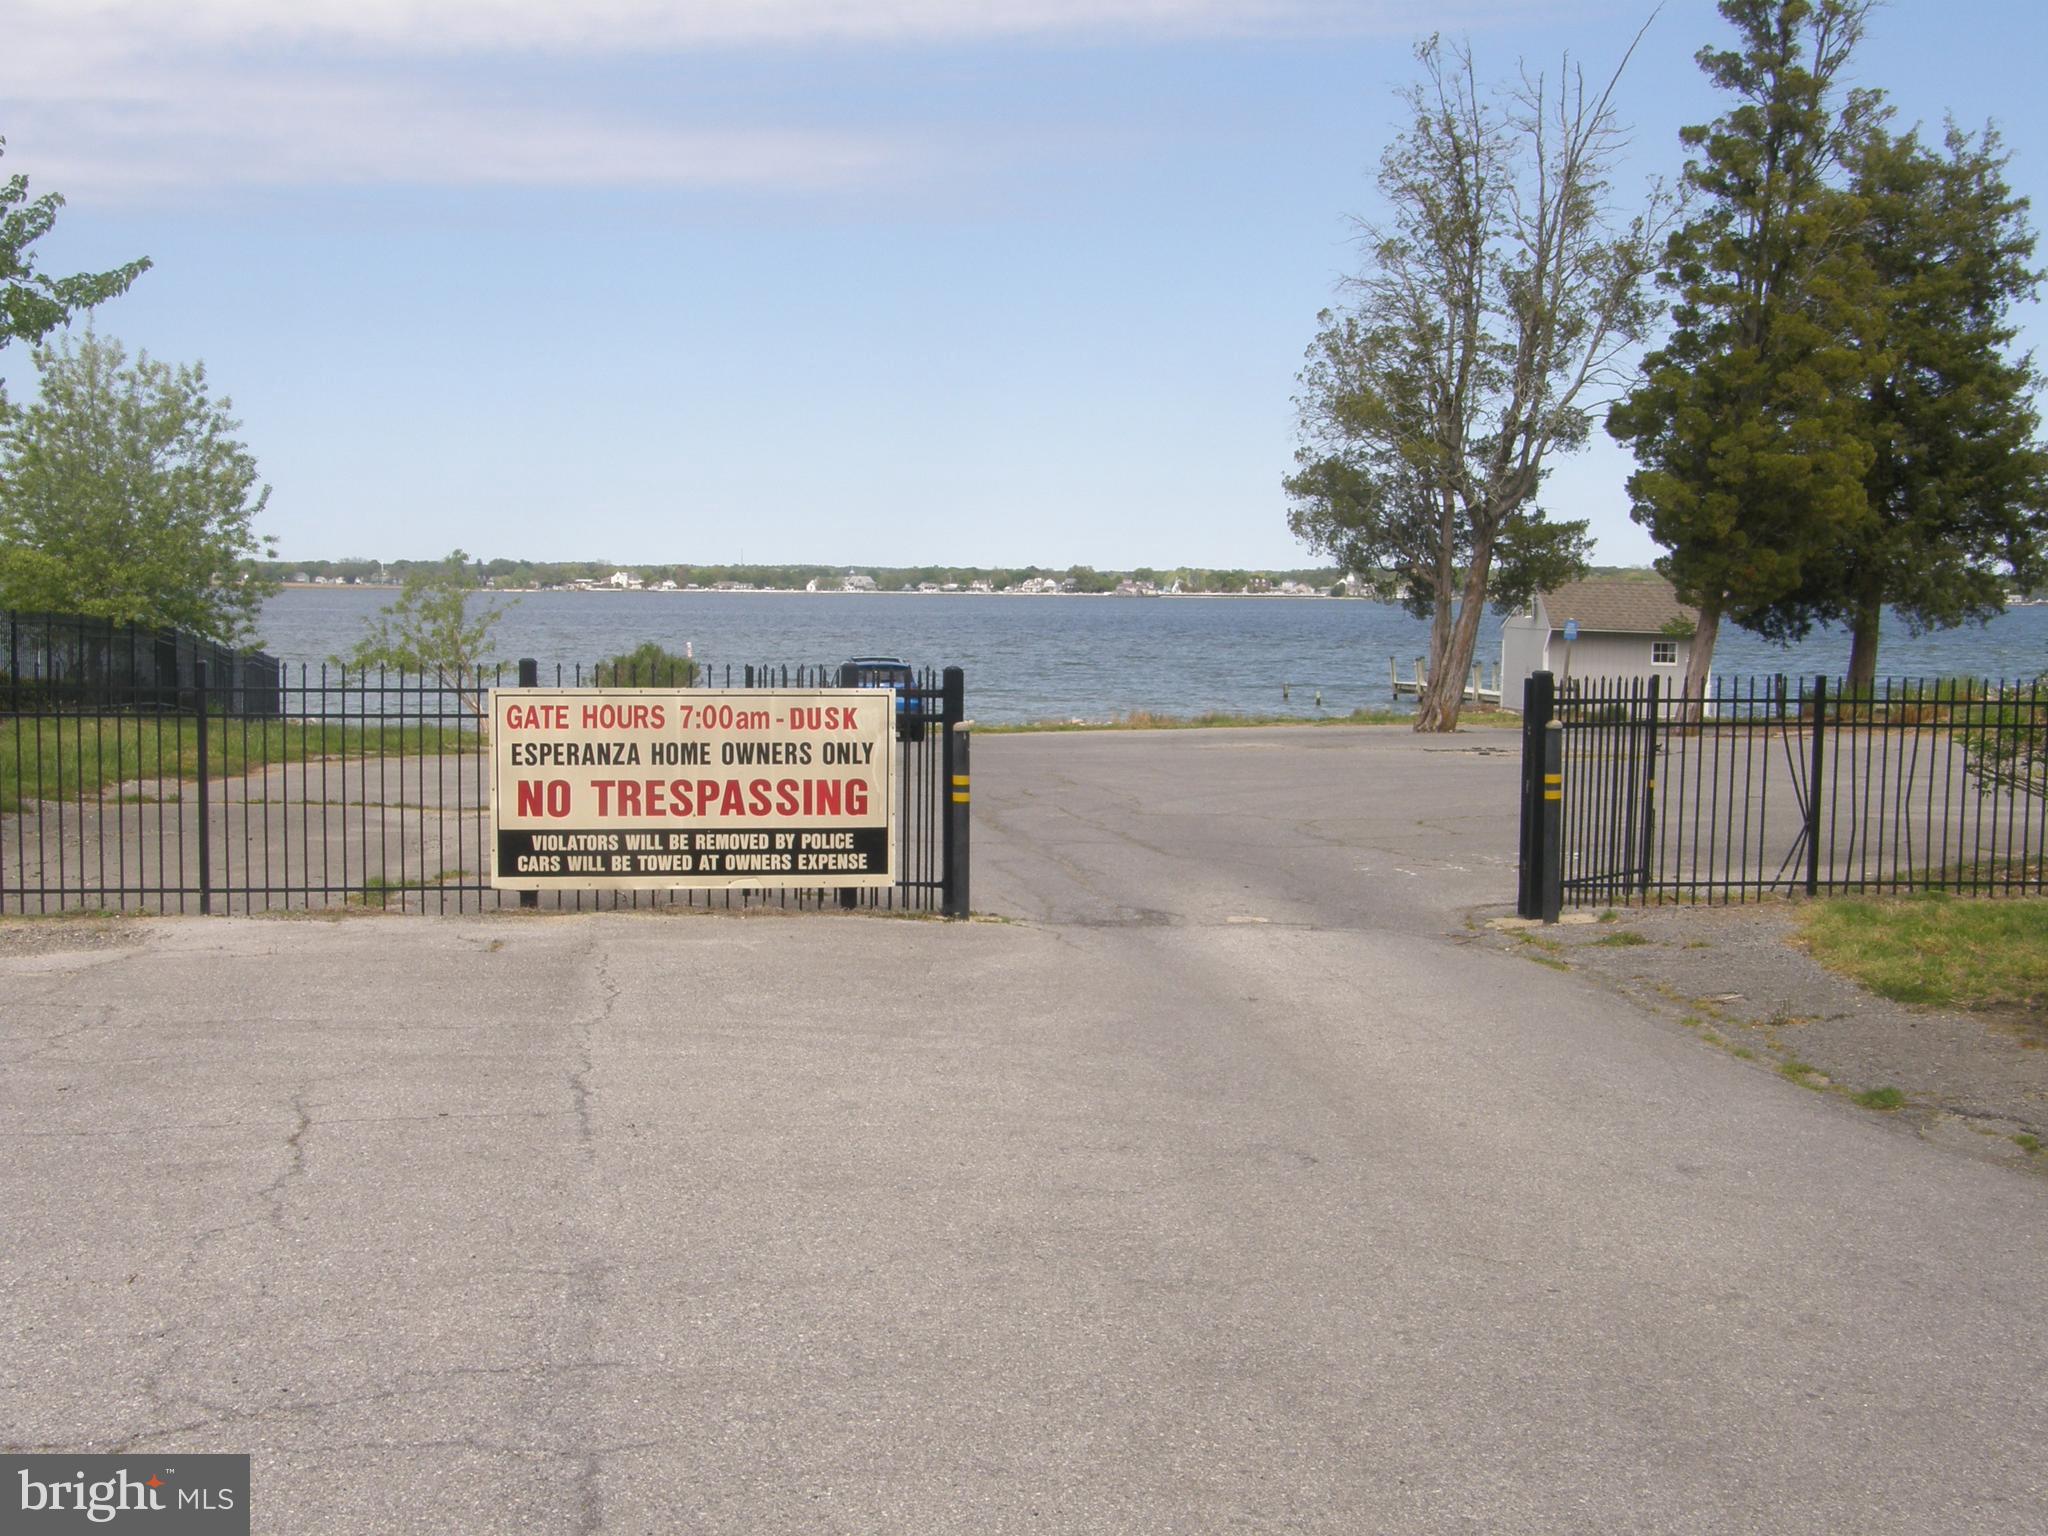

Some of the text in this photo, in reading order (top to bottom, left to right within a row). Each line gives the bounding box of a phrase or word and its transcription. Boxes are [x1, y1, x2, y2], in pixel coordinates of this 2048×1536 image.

[506, 704, 569, 729] GATE
[582, 704, 665, 729] HOURS
[680, 705, 770, 729] 7:00am
[790, 707, 858, 730] DUSK
[511, 742, 874, 766] ESPERANZA HOME OWNERS ONLY
[517, 778, 868, 817] NO TRESPASSING
[532, 833, 854, 851] VIOLATORS WILL BE REMOVED BY POLICE
[517, 854, 867, 872] CARS WILL BE TOWED AT OWNERS EXPENSE
